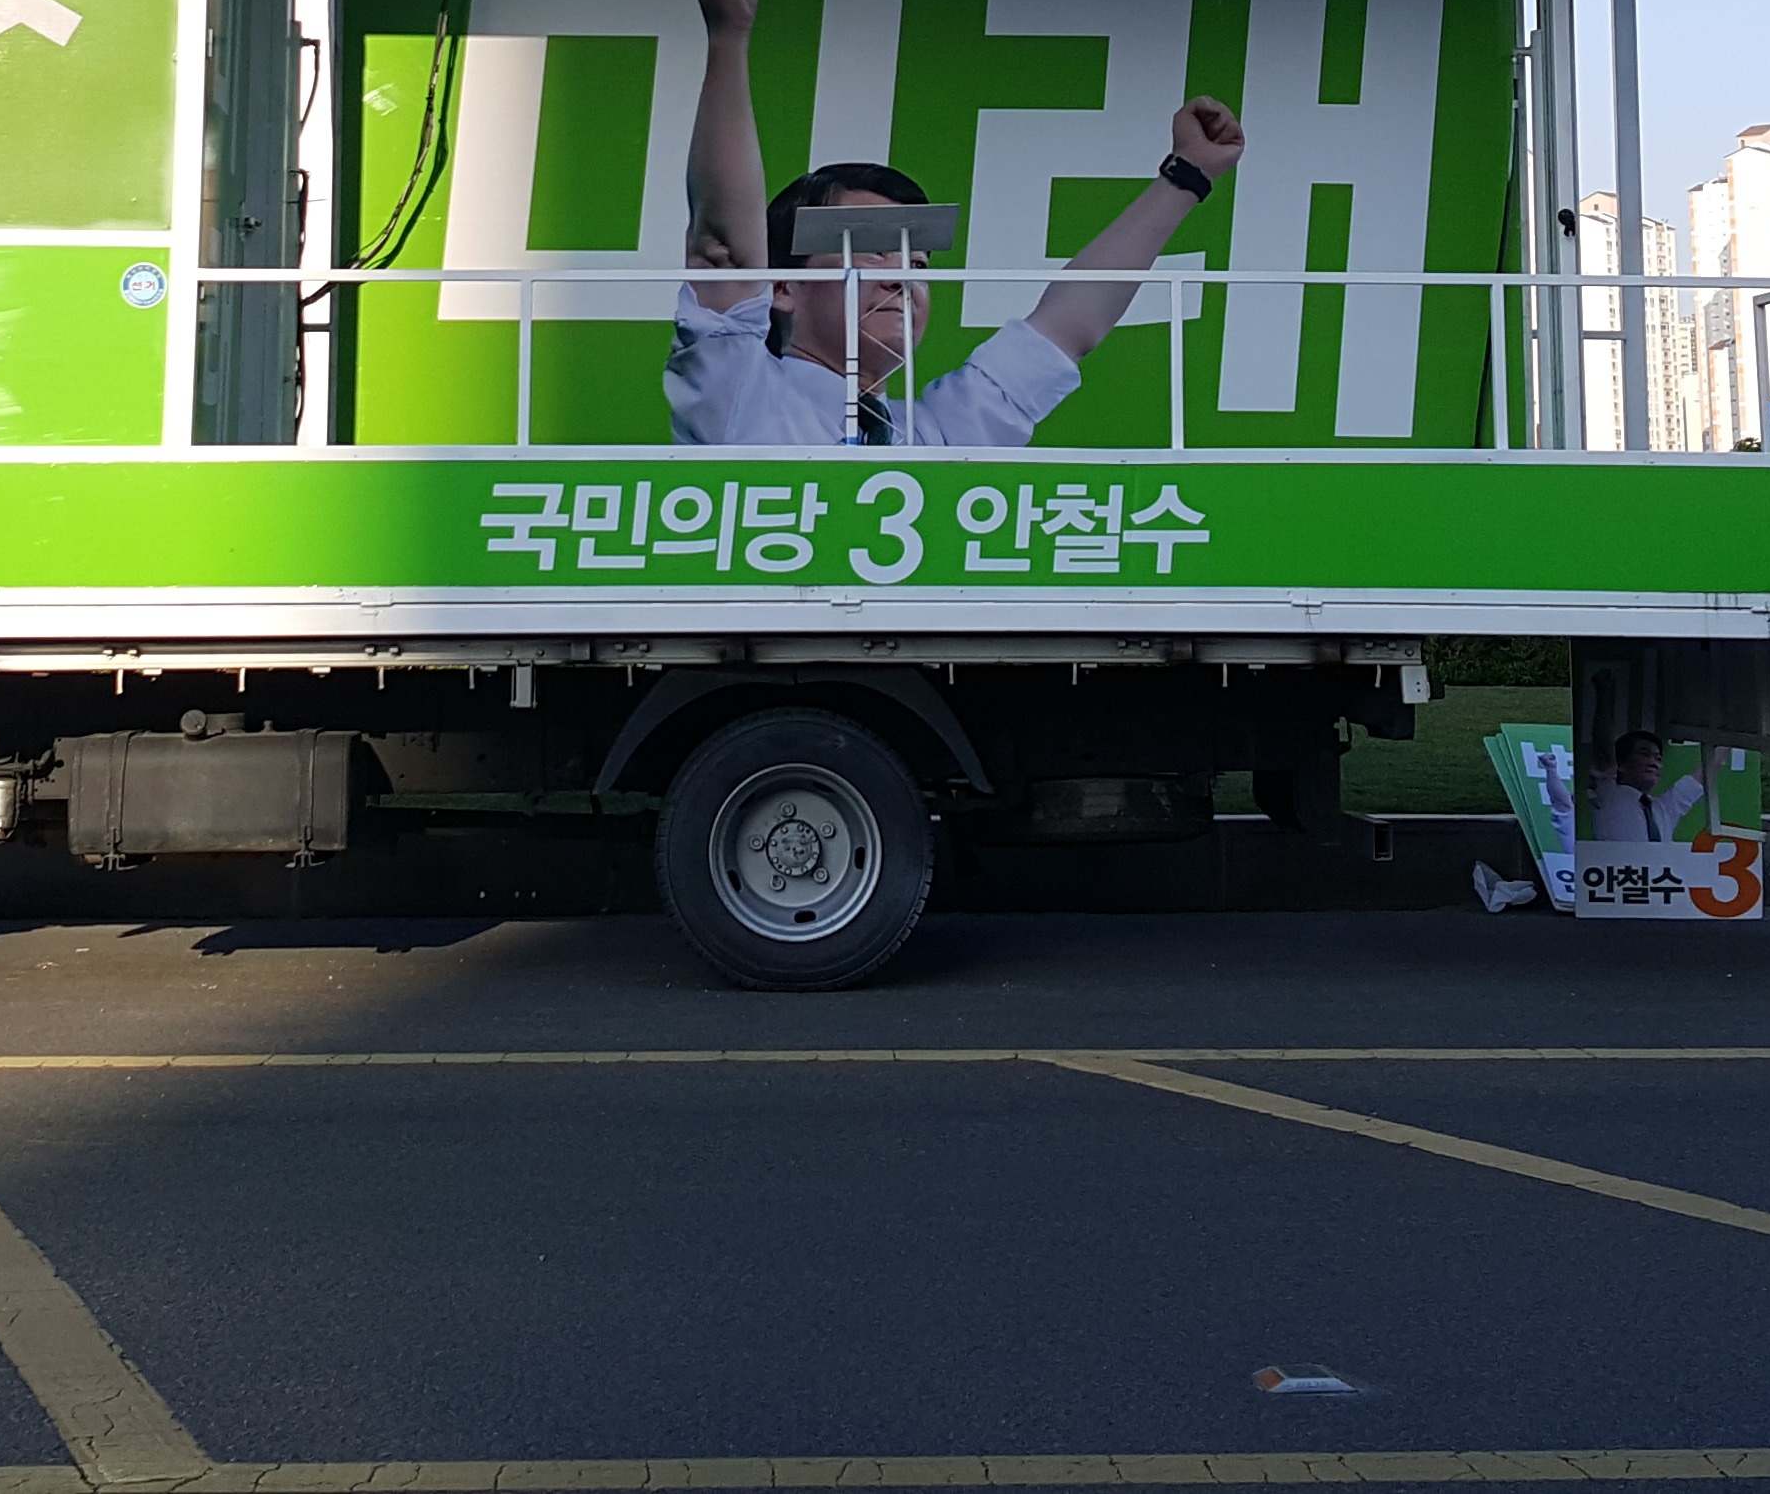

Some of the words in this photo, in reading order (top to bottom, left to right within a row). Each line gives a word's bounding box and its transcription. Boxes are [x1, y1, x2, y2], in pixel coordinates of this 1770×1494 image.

[479, 480, 828, 573] 국민의당
[847, 470, 926, 585] 3
[955, 482, 1211, 574] 안철수
[1583, 864, 1685, 904] 안철수
[1687, 821, 1761, 918] 3
